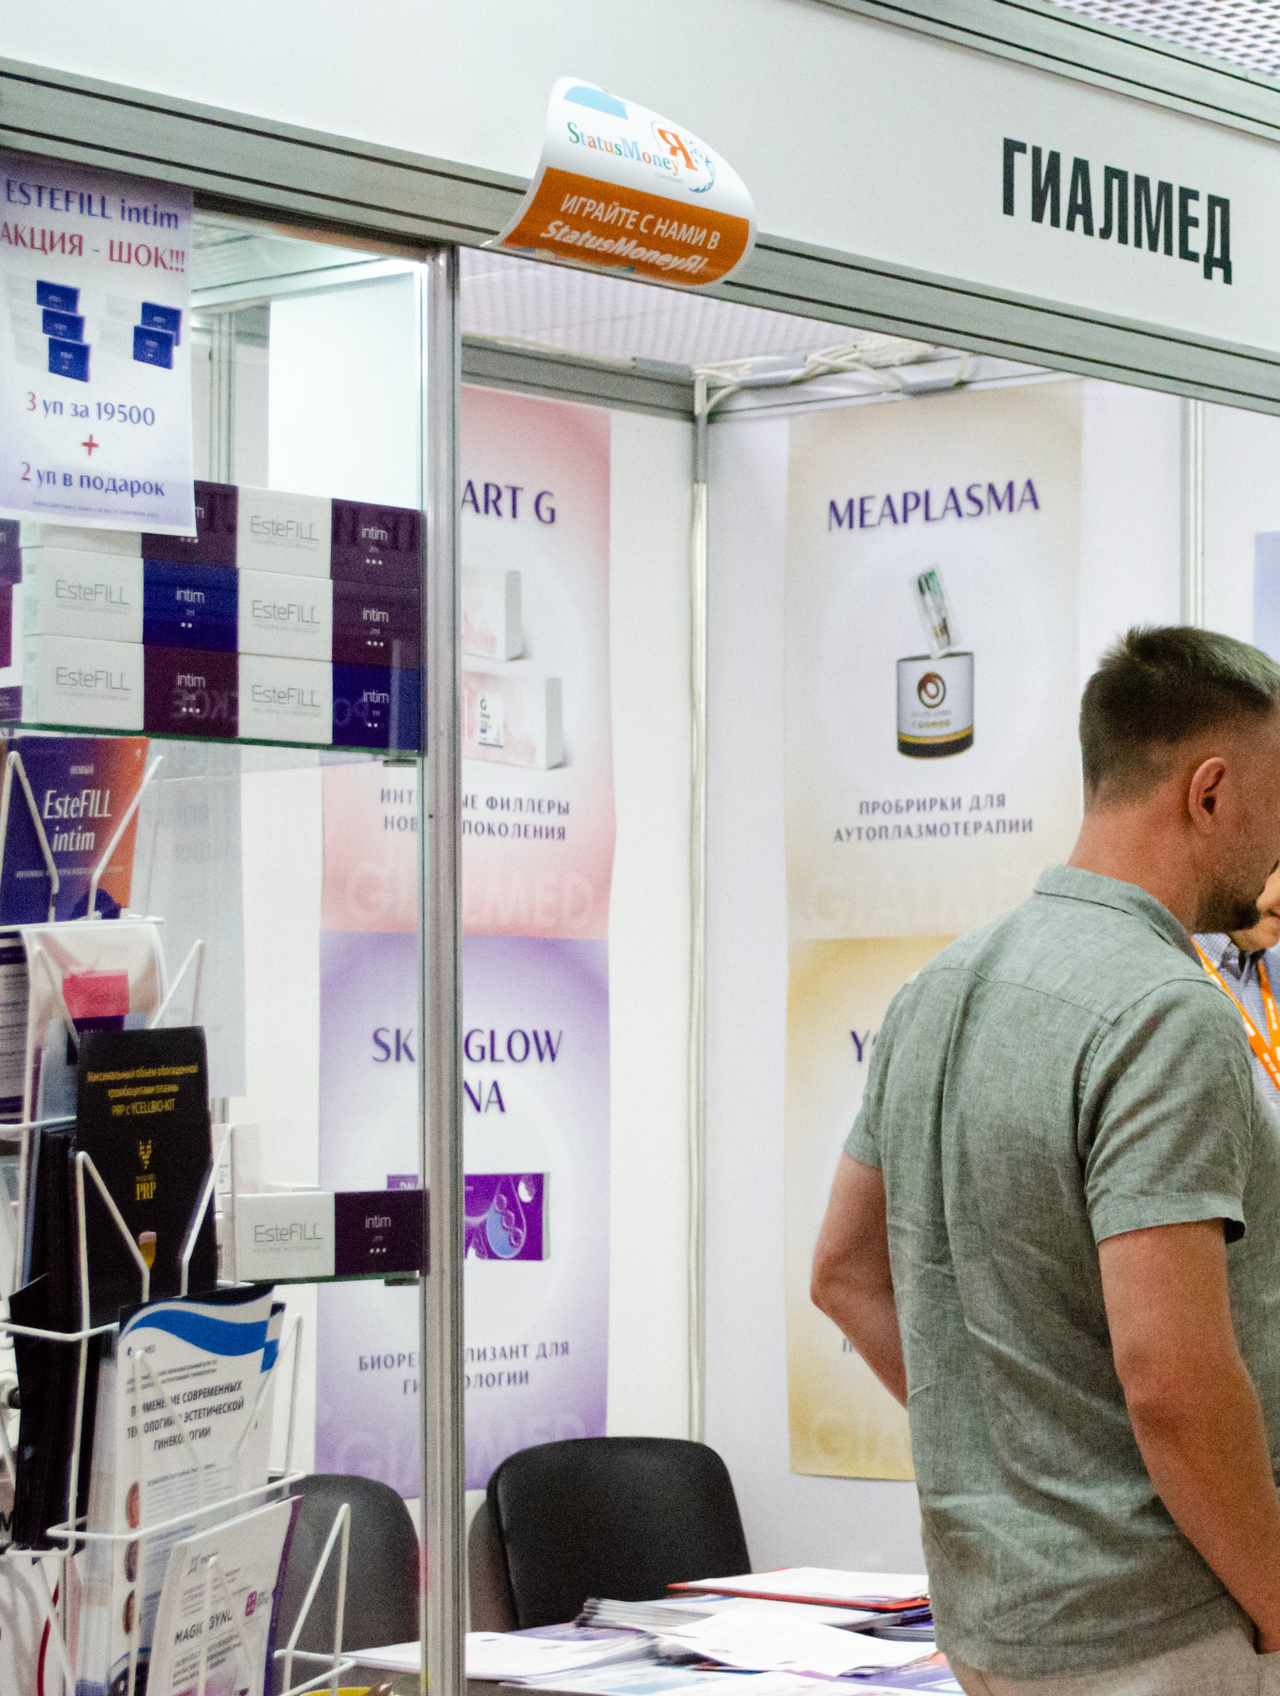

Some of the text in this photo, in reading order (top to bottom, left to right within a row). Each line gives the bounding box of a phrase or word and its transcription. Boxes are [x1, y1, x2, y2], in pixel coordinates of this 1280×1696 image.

[6, 178, 179, 230] ESTEFILL intim
[1003, 137, 1232, 285] ГИАЛМЕД
[560, 193, 721, 250] ИГРАЙТЕ С НАМИ В
[0, 221, 84, 257] АКЦИЯ
[109, 239, 186, 273] ШОК!!!
[26, 391, 156, 426] 3 уп за 19500
[21, 461, 166, 498] 2 уп в подарок
[533, 490, 557, 525] G
[828, 478, 1041, 532] MEAPLASMA
[250, 515, 319, 542] EsteFILL
[361, 524, 388, 541] intim
[55, 579, 130, 605] EsteFILL
[176, 587, 205, 604] intim
[252, 600, 320, 624] EsteFILL
[363, 607, 389, 623] intim
[55, 667, 131, 691] EsteFILL
[177, 672, 205, 688] intim
[251, 684, 321, 708] EsteFILL
[363, 688, 389, 704] intim
[44, 789, 112, 819] EsteFILL
[485, 796, 570, 816] ФИЛЛЕРЫ
[969, 793, 1007, 812] ДЛЯ
[53, 825, 95, 852] intim
[462, 820, 567, 840] ПОКОЛЕНИЯ
[834, 818, 1033, 843] АУТОПЛАЗМОТЕРАПИИ
[464, 1028, 563, 1063] GLOW
[464, 1079, 506, 1113] NA
[136, 1182, 157, 1201] PRP
[254, 1222, 323, 1244] EsteFILL
[365, 1214, 392, 1229] intim
[536, 1341, 570, 1361] ДЛЯ
[182, 1380, 243, 1404] СОВРЕМЕННЫХ
[183, 1396, 245, 1423] ЭСТЕТИЧЕСКОЙ
[154, 1426, 212, 1451] ГИНЕКООГИИ
